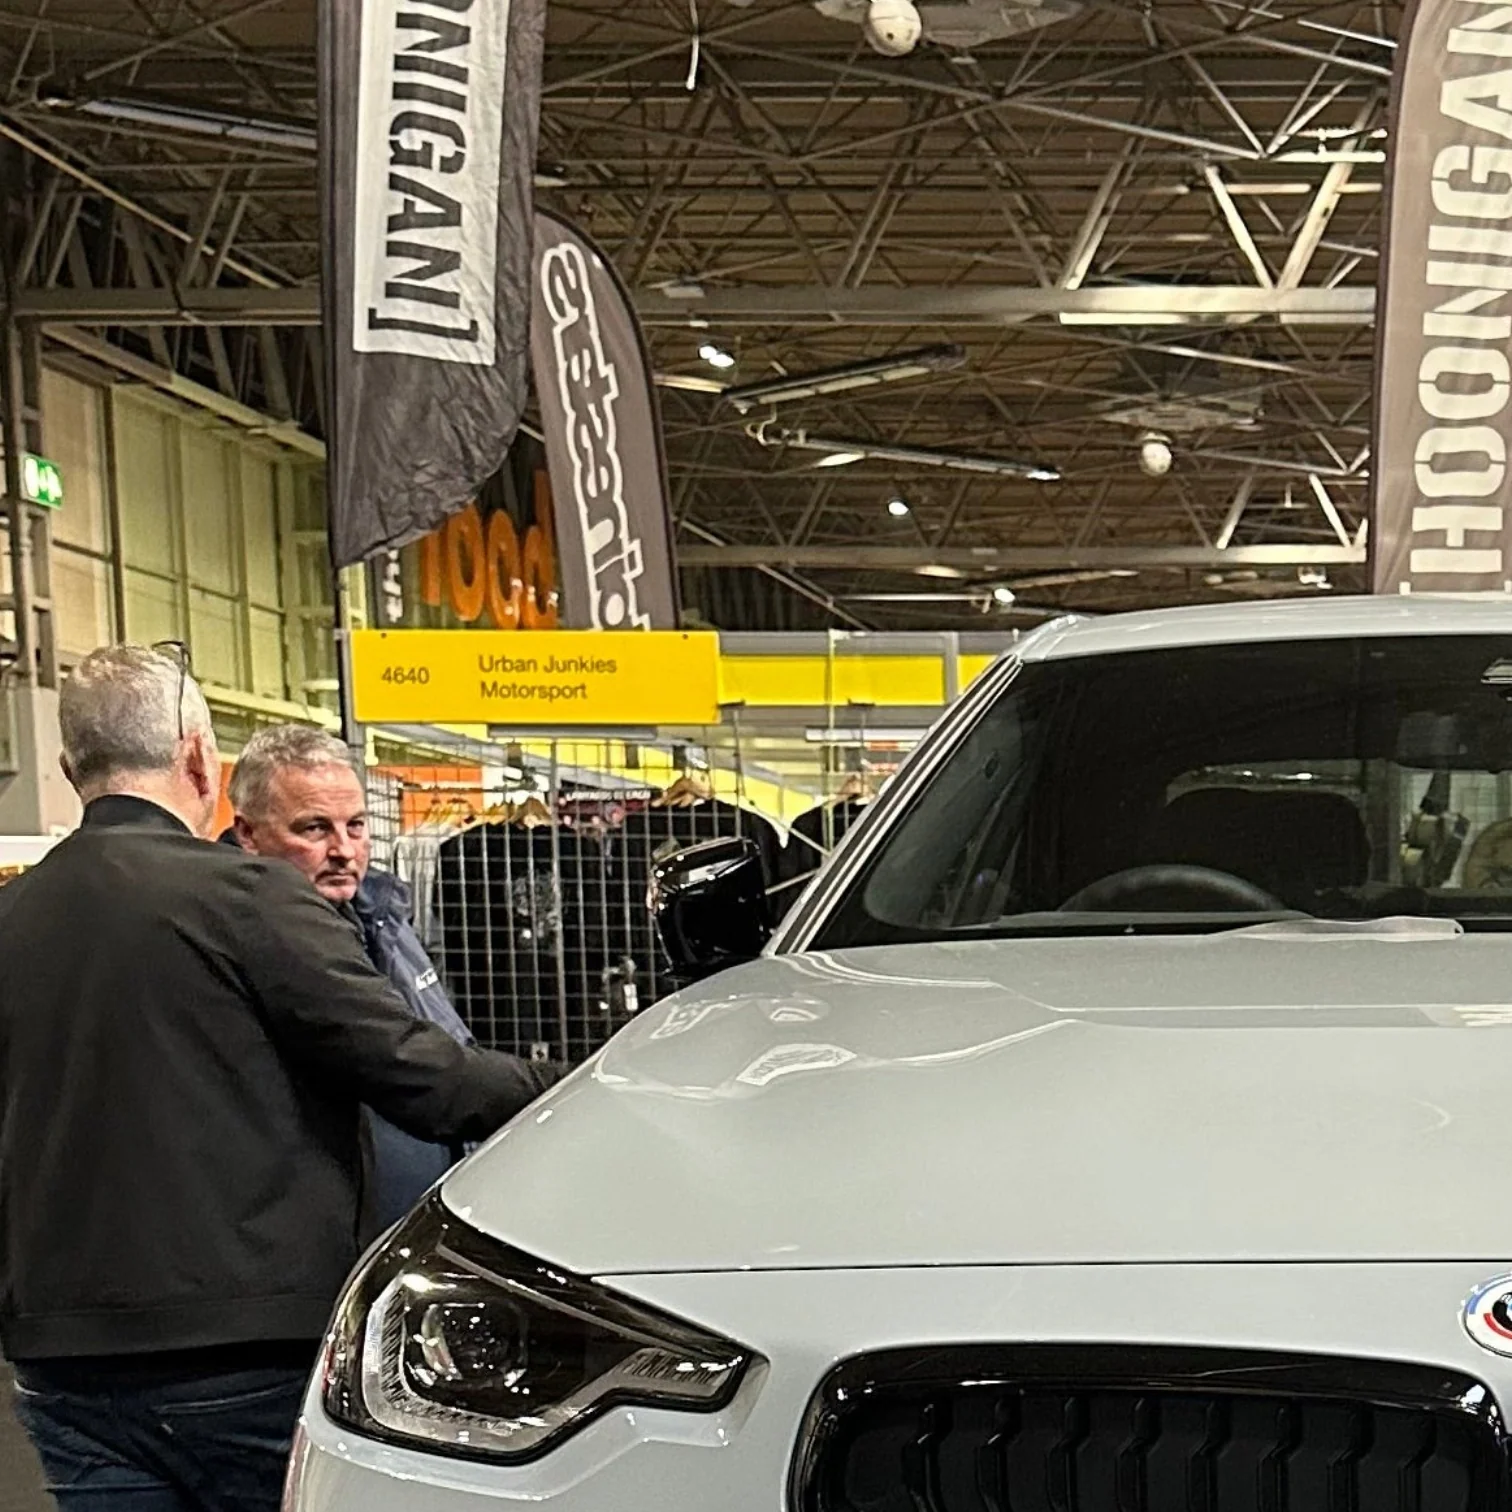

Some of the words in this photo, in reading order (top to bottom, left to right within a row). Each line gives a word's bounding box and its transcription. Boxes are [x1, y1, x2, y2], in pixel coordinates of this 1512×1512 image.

[368, 0, 479, 343] NIGAN]
[478, 655, 538, 673] Urban
[543, 655, 618, 673] Junkies
[381, 667, 430, 685] 4640
[480, 681, 588, 701] Motorsport
